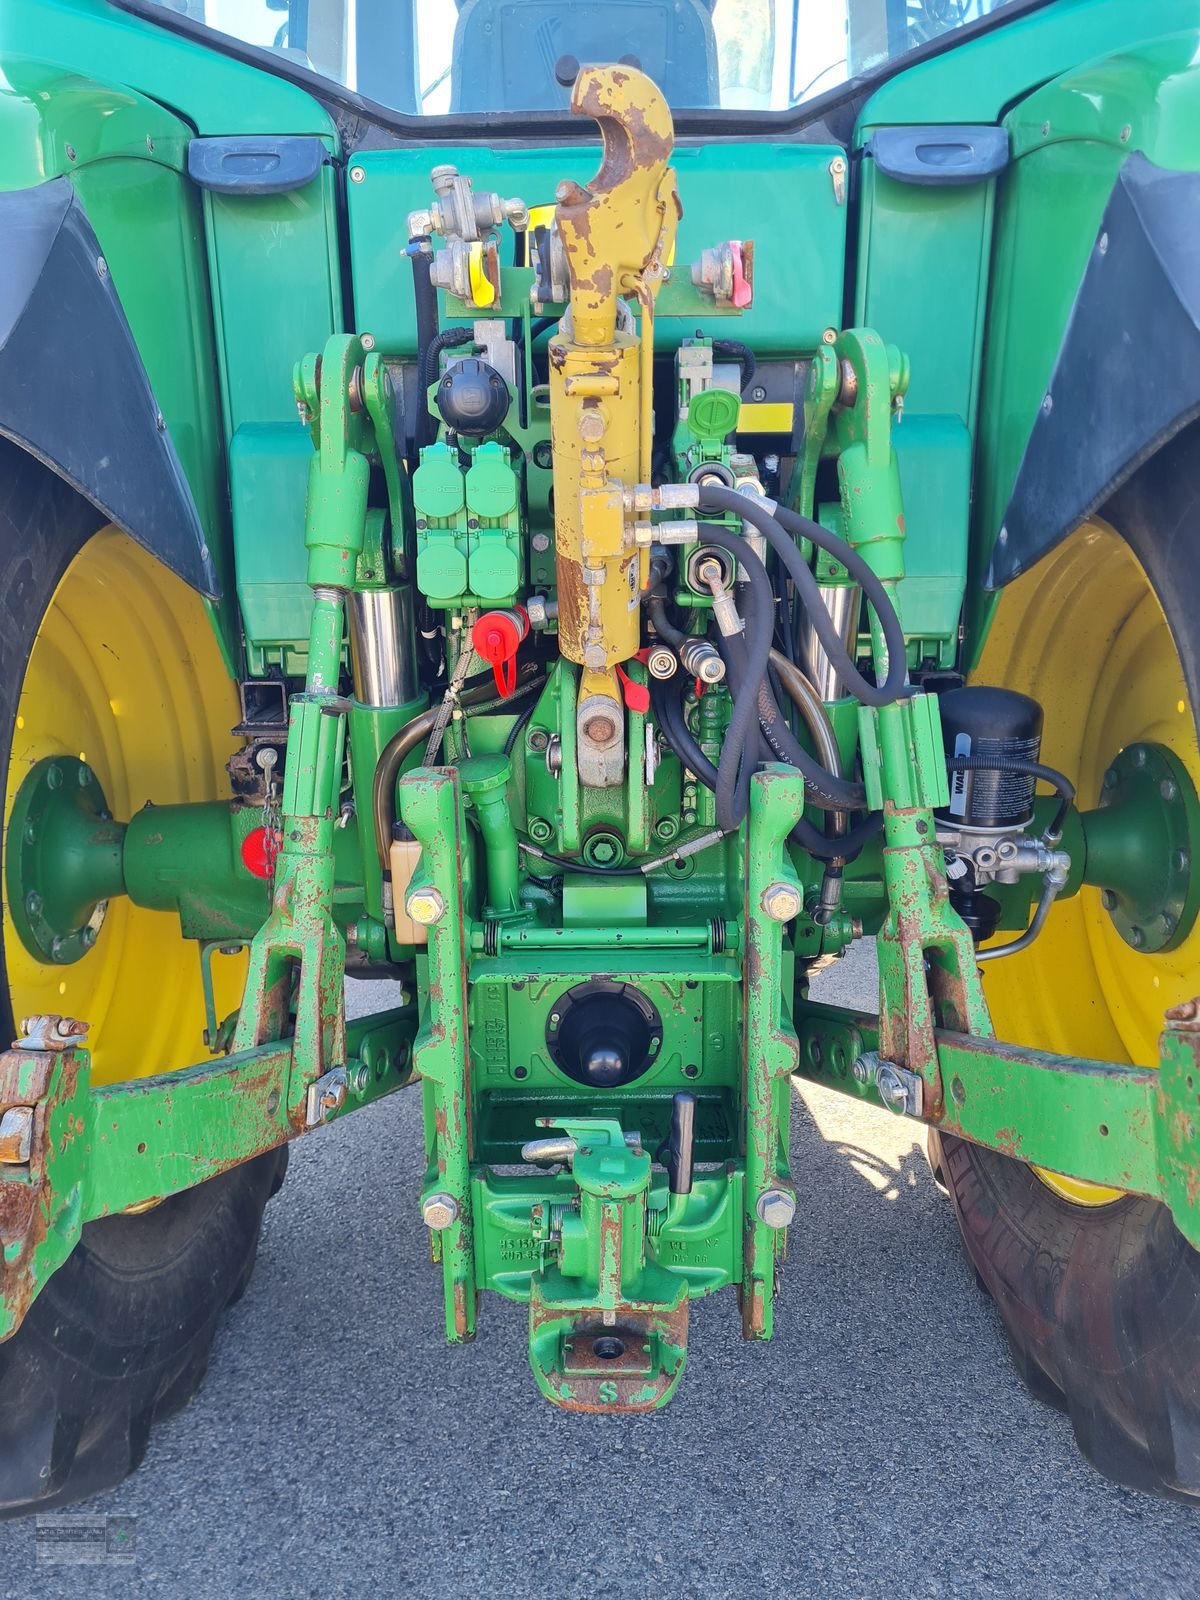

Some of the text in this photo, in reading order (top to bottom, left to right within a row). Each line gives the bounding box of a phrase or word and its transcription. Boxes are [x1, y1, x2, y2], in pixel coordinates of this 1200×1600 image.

[770, 737, 781, 749] EN
[955, 753, 967, 795] WAB
[599, 1381, 618, 1404] S
